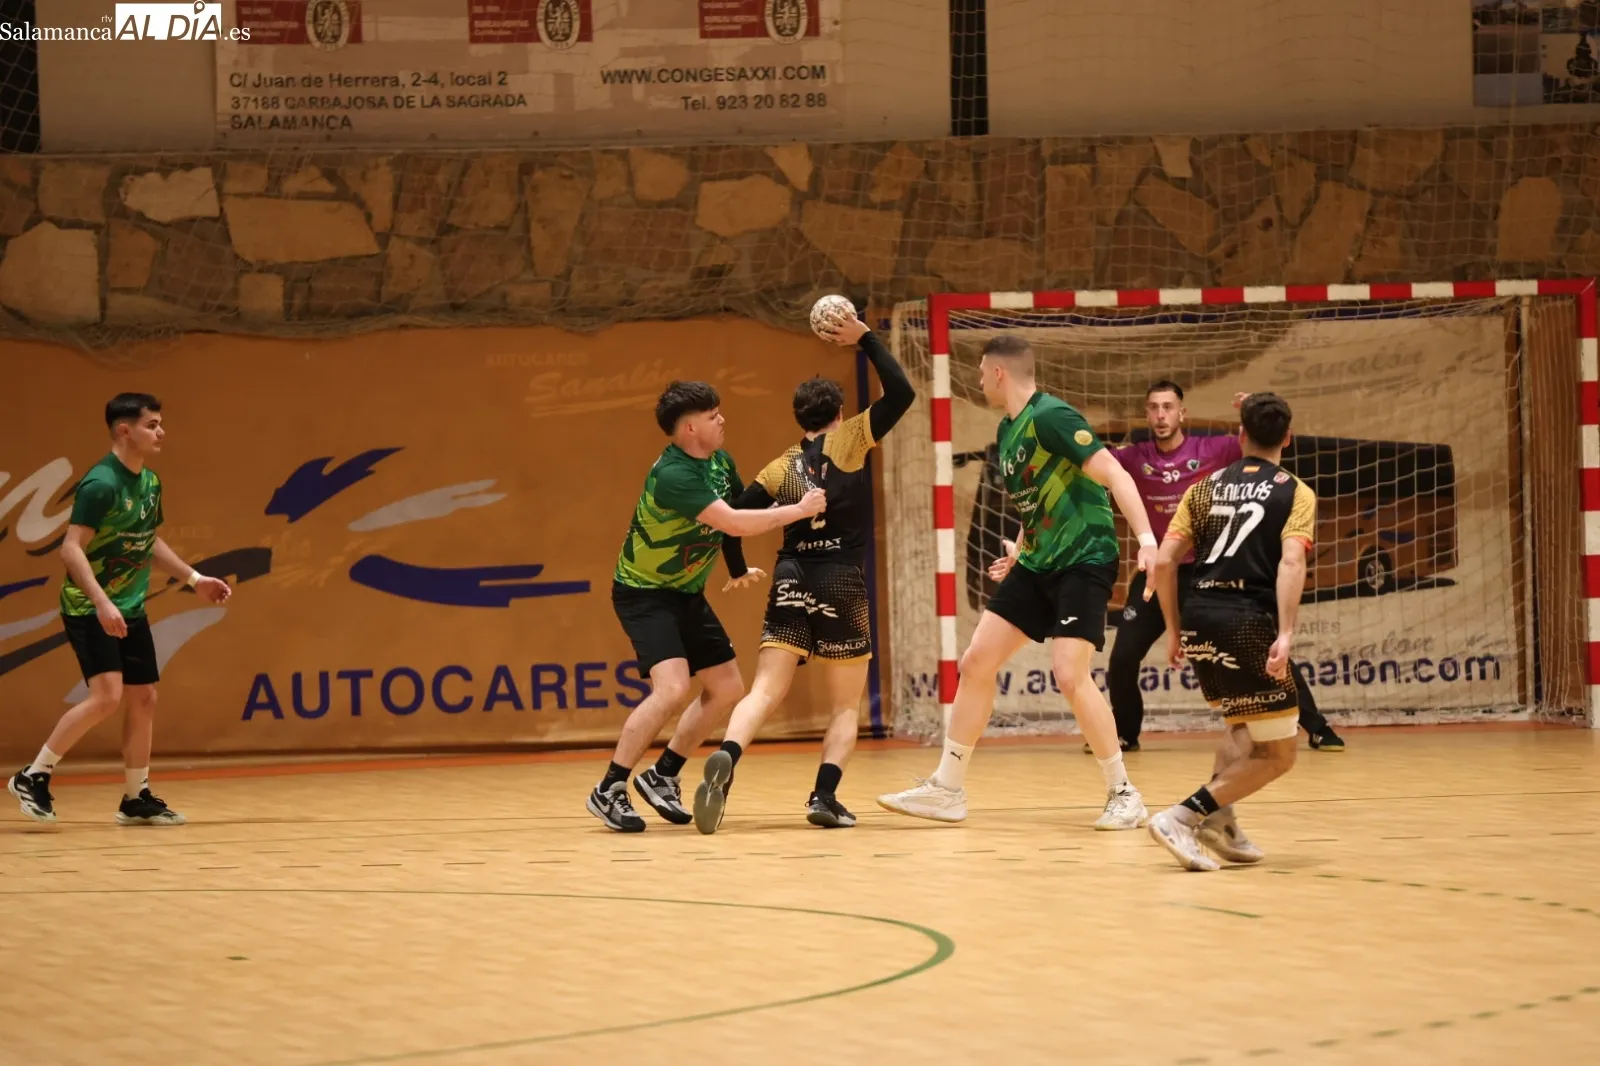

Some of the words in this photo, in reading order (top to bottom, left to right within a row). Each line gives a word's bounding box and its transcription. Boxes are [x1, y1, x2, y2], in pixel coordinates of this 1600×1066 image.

[252, 72, 297, 88] Juan
[301, 72, 324, 88] de
[328, 71, 406, 89] Herrera,
[411, 71, 445, 89] 2-4,
[450, 71, 493, 87] local
[497, 71, 509, 86] 2
[600, 65, 827, 85] WWW.CONGESAXXI.COM
[284, 95, 389, 109] CARBAJOSA
[393, 94, 417, 109] DE
[420, 94, 442, 109] LA
[446, 93, 528, 108] SAGRADA
[681, 95, 710, 111] Tel.
[716, 95, 749, 110] 923
[753, 94, 775, 110] 20
[807, 92, 828, 108] 88
[230, 114, 353, 131] SALAMANCA
[1003, 458, 1015, 477] 16
[1162, 469, 1181, 484] 39
[140, 503, 147, 520] 6
[1204, 501, 1265, 564] 77
[241, 660, 651, 722] AUTOCARES
[1221, 692, 1287, 711] GUINALDO
